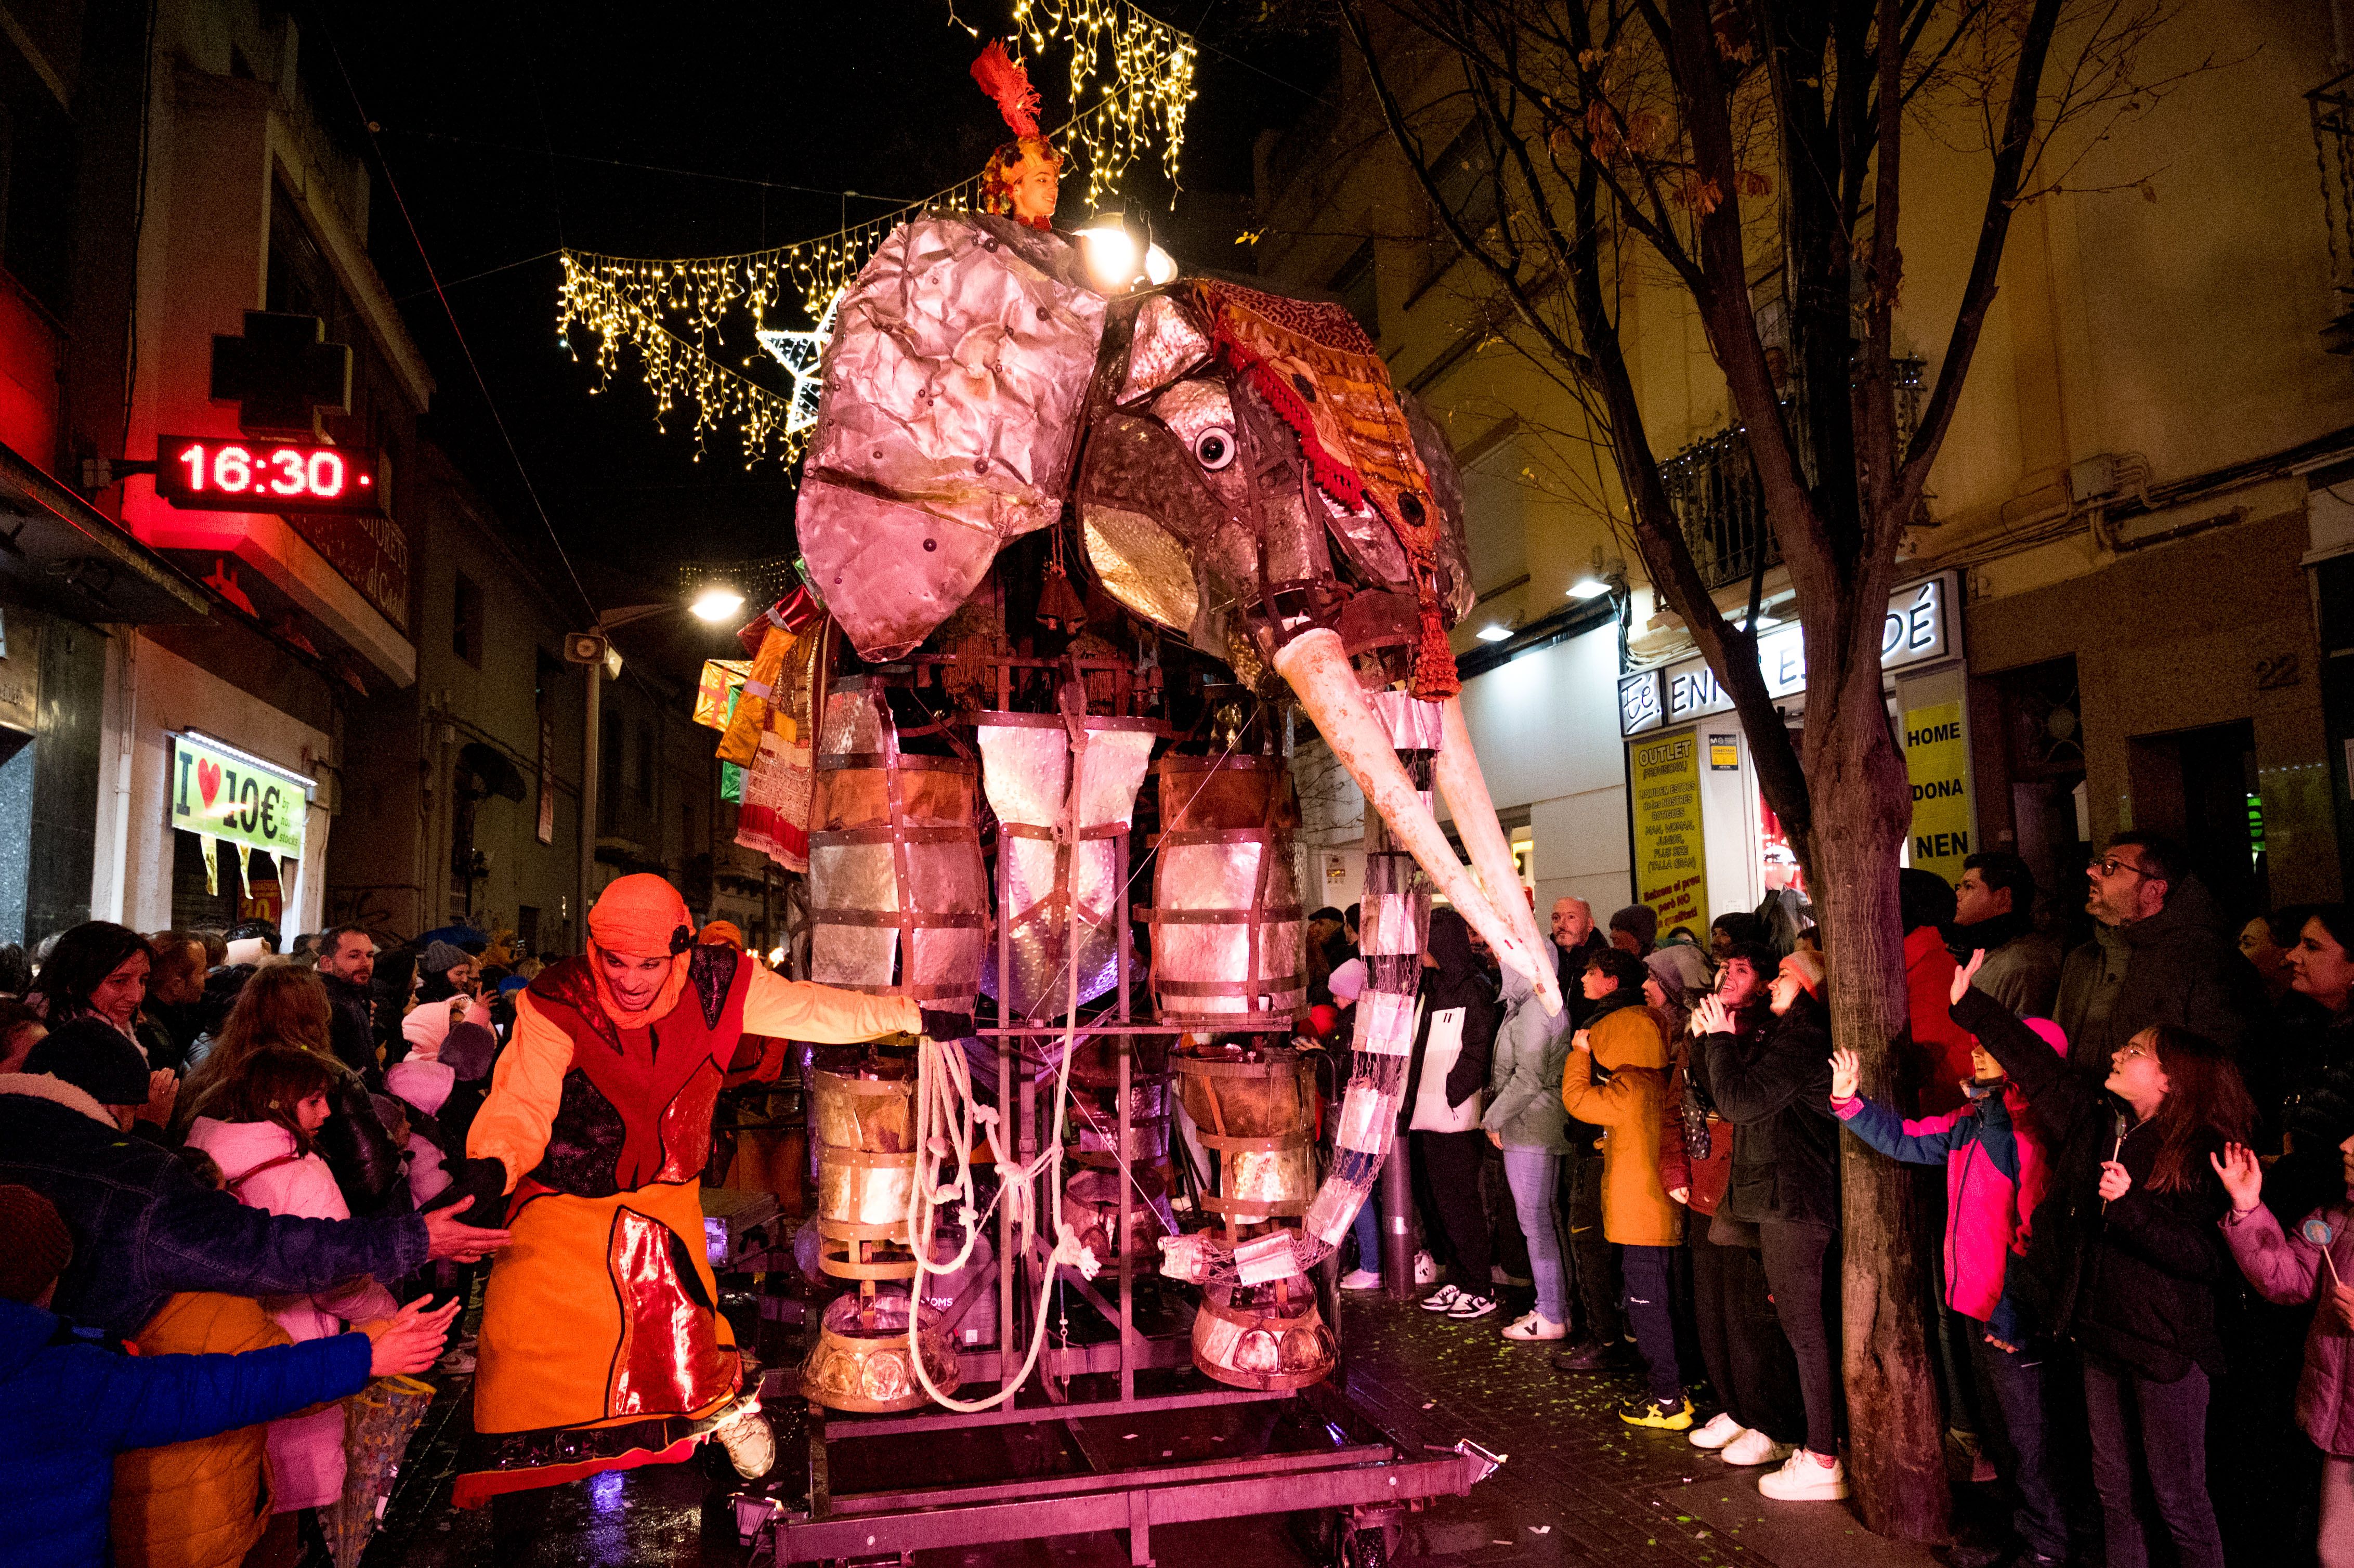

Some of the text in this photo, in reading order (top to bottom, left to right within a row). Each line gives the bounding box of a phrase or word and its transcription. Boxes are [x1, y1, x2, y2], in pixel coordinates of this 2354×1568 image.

[180, 443, 344, 497] 16:30
[2256, 654, 2300, 690] 22
[1907, 722, 1960, 747] HOME
[1639, 740, 1691, 767] OUTLET
[1643, 761, 1688, 780] (PROVISIONAL)
[176, 751, 280, 839] I 10€
[1639, 782, 1695, 800] LIQUIDEM ESTOCS
[1913, 778, 1964, 801] DONA
[282, 796, 290, 813] by
[1652, 800, 1661, 809] les
[1662, 795, 1692, 808] NOSTRES
[1652, 808, 1684, 821] BOTIGUES
[279, 833, 298, 846] stocks
[1916, 831, 1968, 858] NEN
[1654, 846, 1689, 859] PLUS SIZE
[1648, 856, 1696, 873] (TALLA GRAN)
[1644, 875, 1701, 902] Baixem el preu
[1658, 893, 1691, 914] però NO
